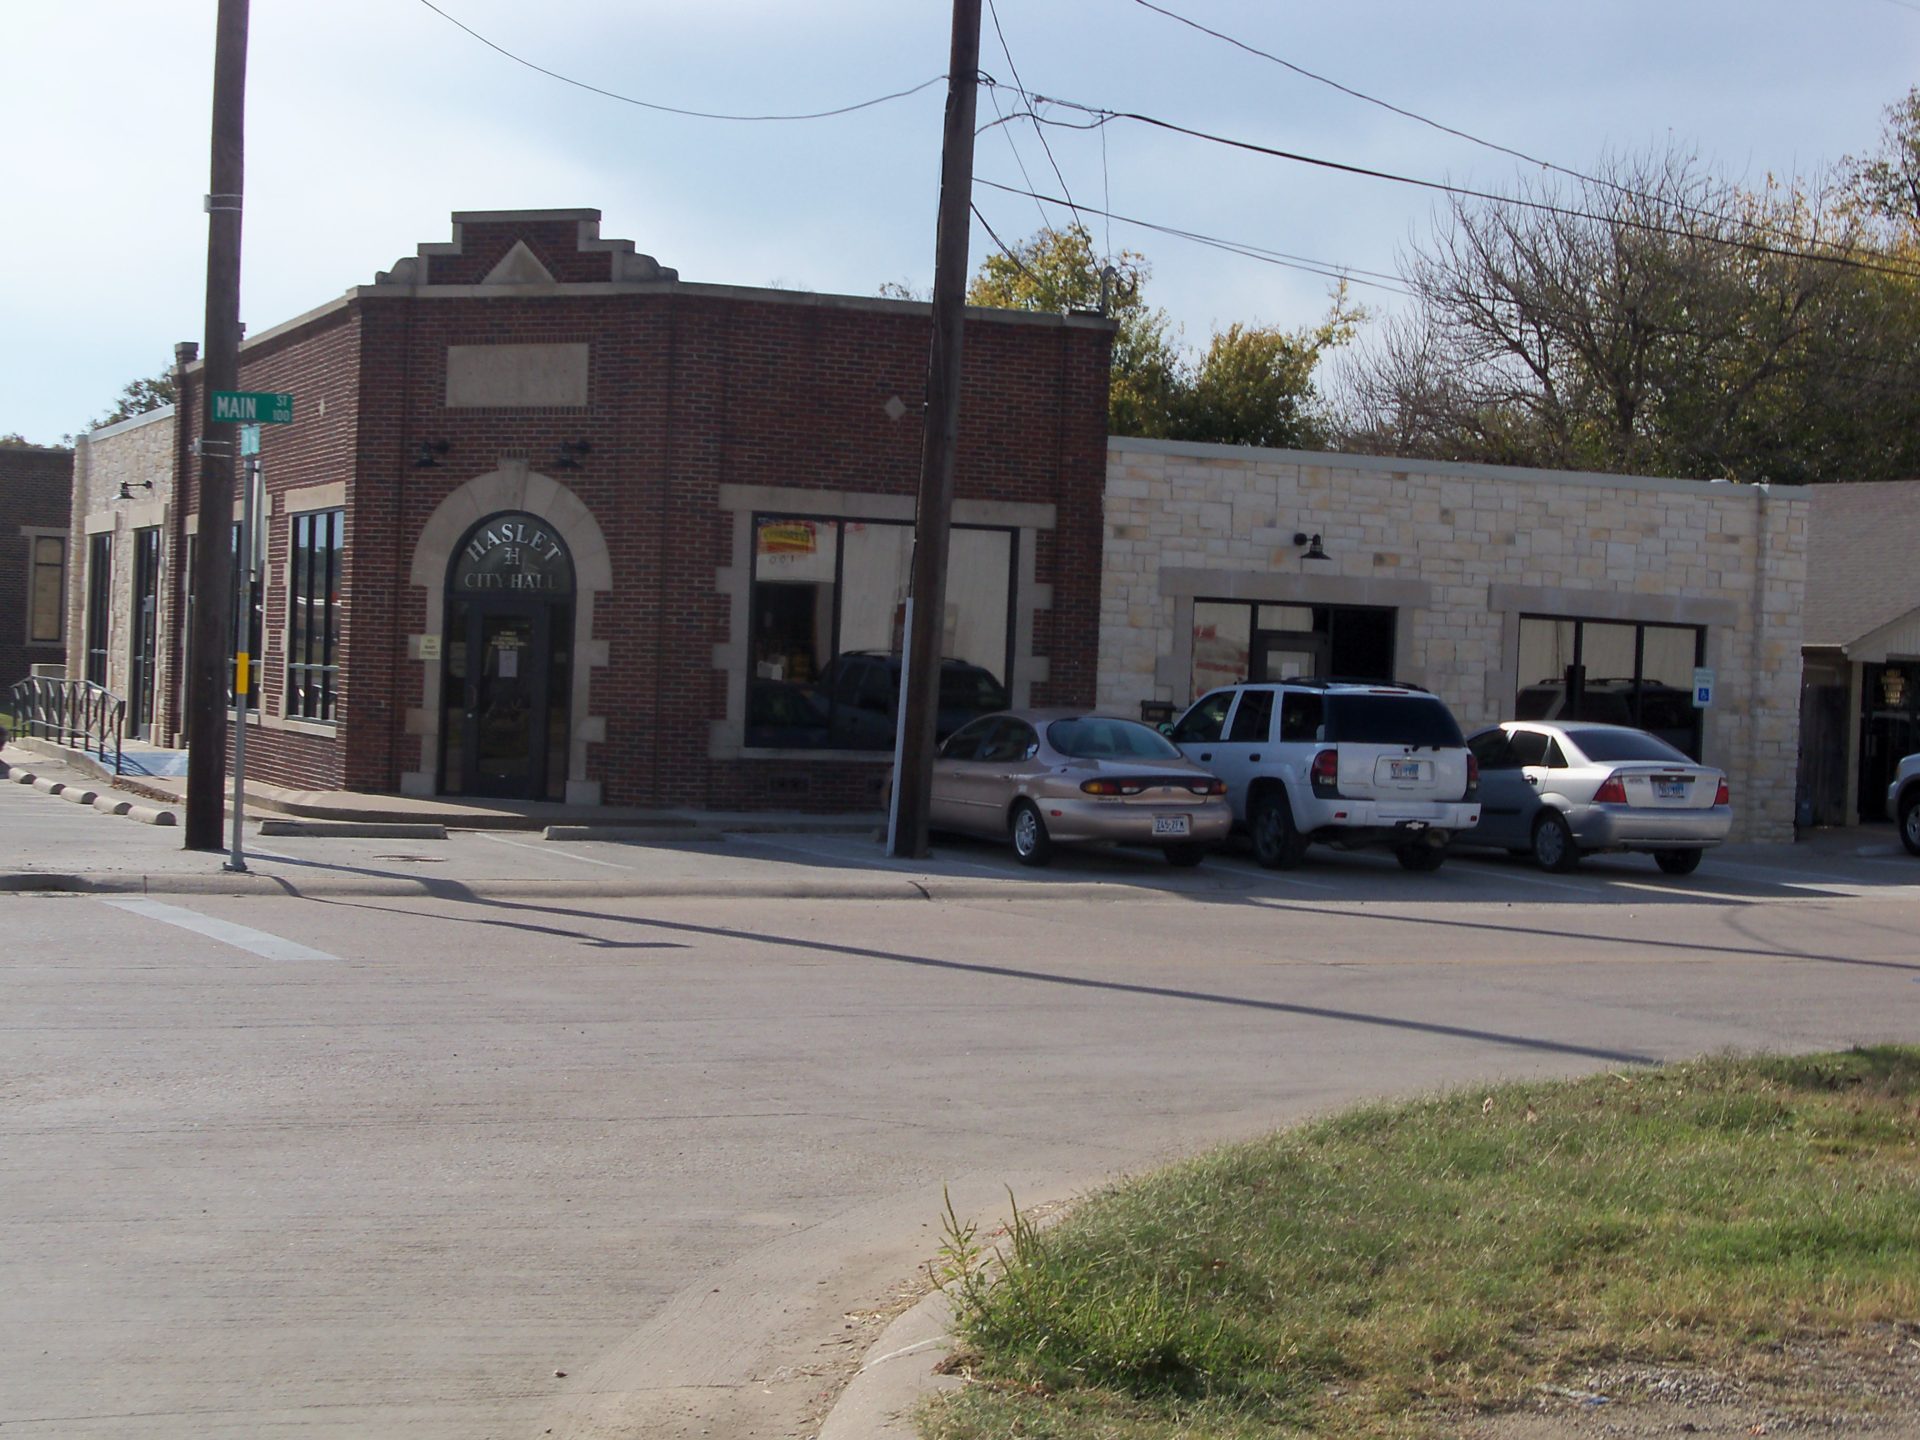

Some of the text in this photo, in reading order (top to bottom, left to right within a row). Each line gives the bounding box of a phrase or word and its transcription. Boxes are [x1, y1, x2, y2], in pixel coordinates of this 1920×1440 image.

[216, 395, 288, 418] MAIN ST
[272, 409, 291, 422] 100
[466, 523, 562, 562] HASLET
[464, 572, 559, 589] CITY HALL
